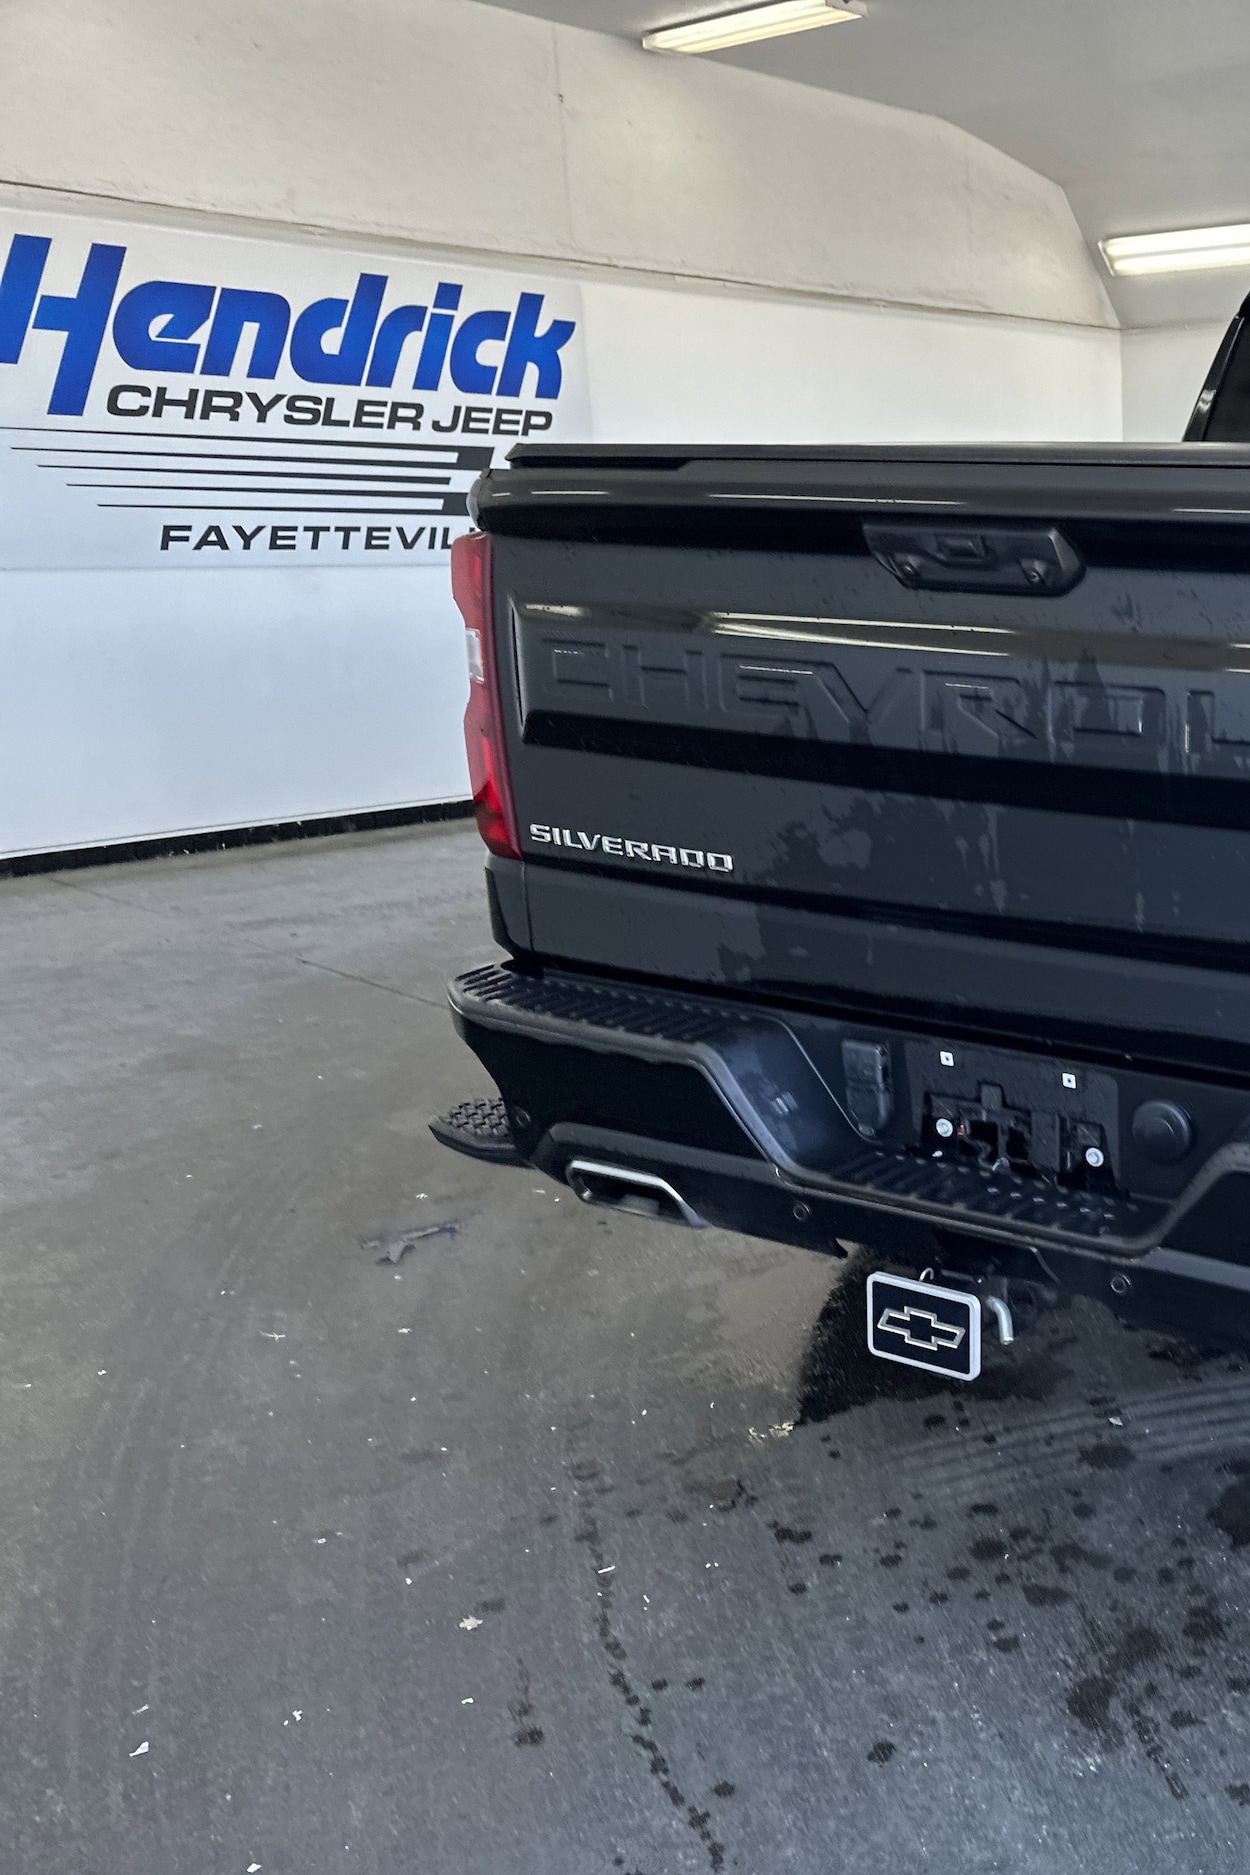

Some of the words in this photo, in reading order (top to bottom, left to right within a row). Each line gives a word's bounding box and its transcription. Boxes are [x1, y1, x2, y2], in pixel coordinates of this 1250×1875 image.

[0, 233, 576, 416] Hendrick
[106, 384, 425, 431] CHRYSLER
[431, 404, 553, 437] JEEP
[160, 524, 475, 551] FAYETTEVIL
[529, 823, 734, 873] SILVERADO
